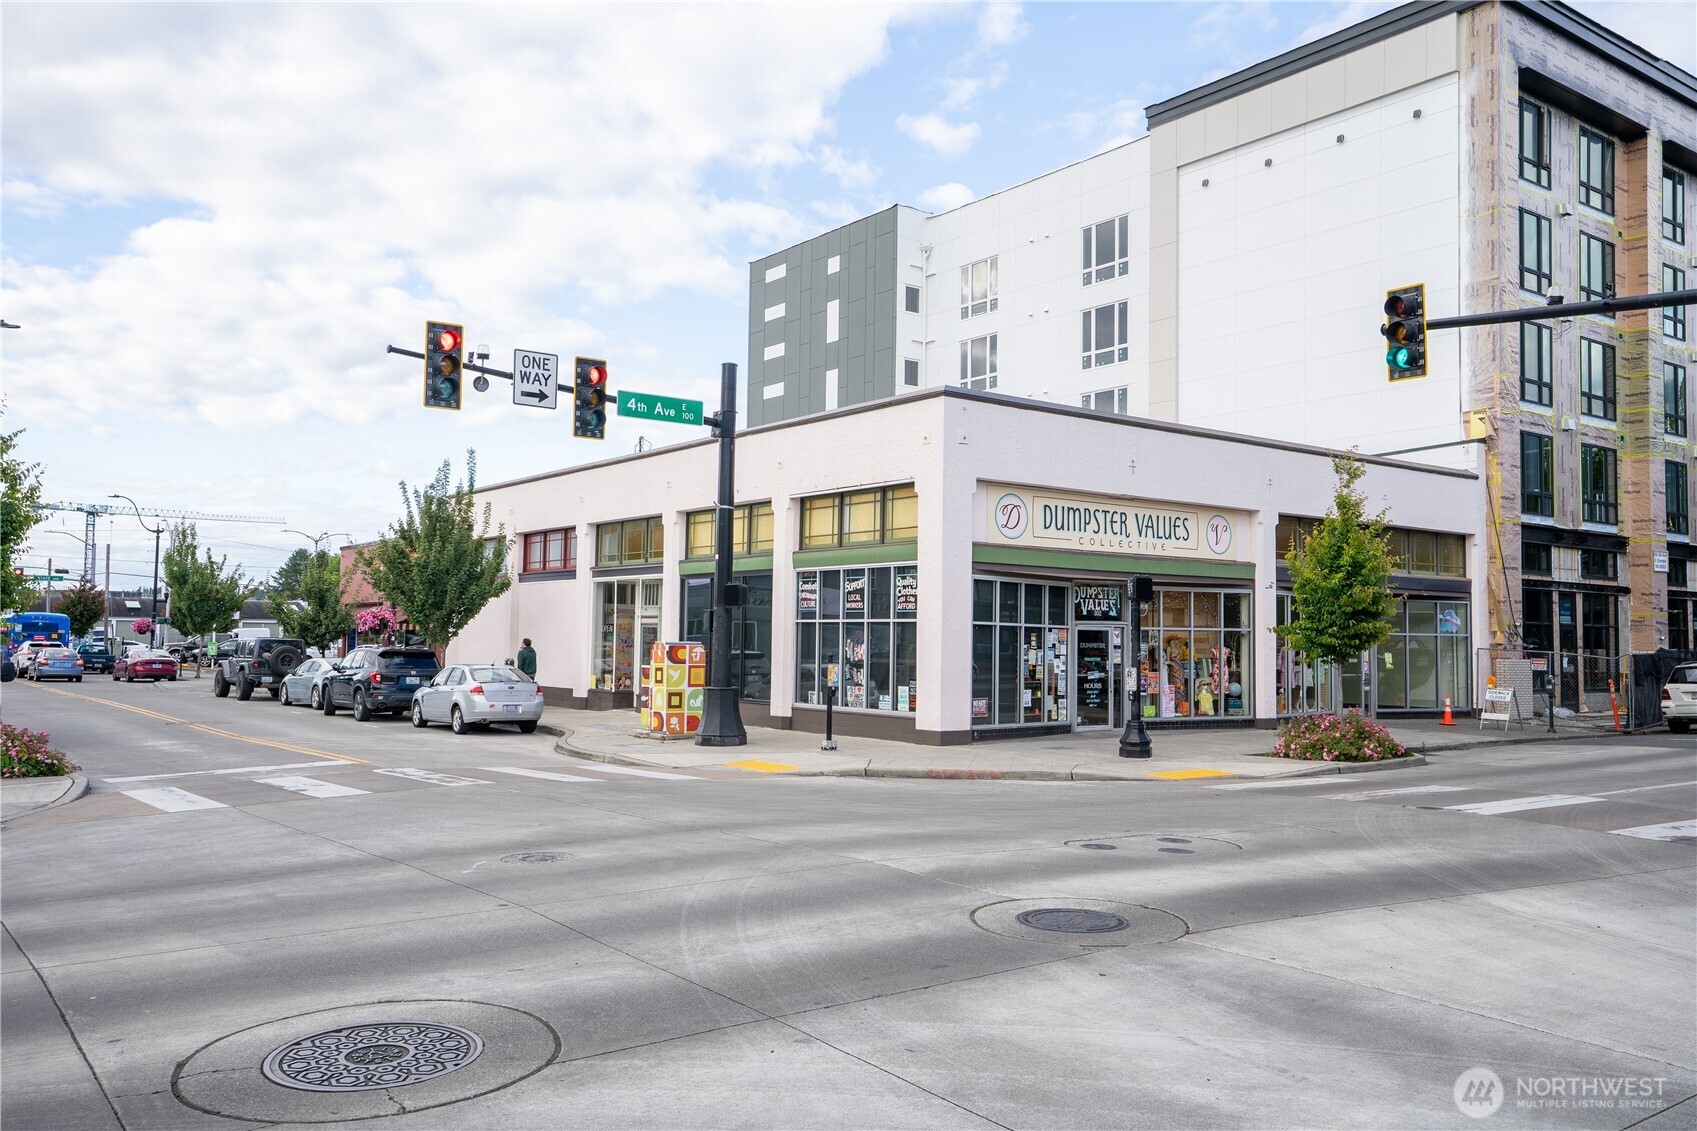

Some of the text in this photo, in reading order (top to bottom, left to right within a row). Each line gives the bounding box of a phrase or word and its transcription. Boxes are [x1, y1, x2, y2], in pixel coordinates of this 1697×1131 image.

[522, 355, 551, 372] ONE
[520, 370, 552, 387] WAY
[627, 398, 675, 416] 4th Ave
[682, 412, 694, 420] 100
[999, 503, 1021, 530] D
[1042, 504, 1190, 541] DUMPSTER VALUES
[1078, 537, 1166, 551] COLLECTIVE
[845, 578, 865, 592] SUPPORT
[896, 576, 916, 588] Quality
[800, 600, 816, 608] CULTURE
[1073, 586, 1120, 608] DUMPSTER
[1080, 599, 1117, 616] VALUES
